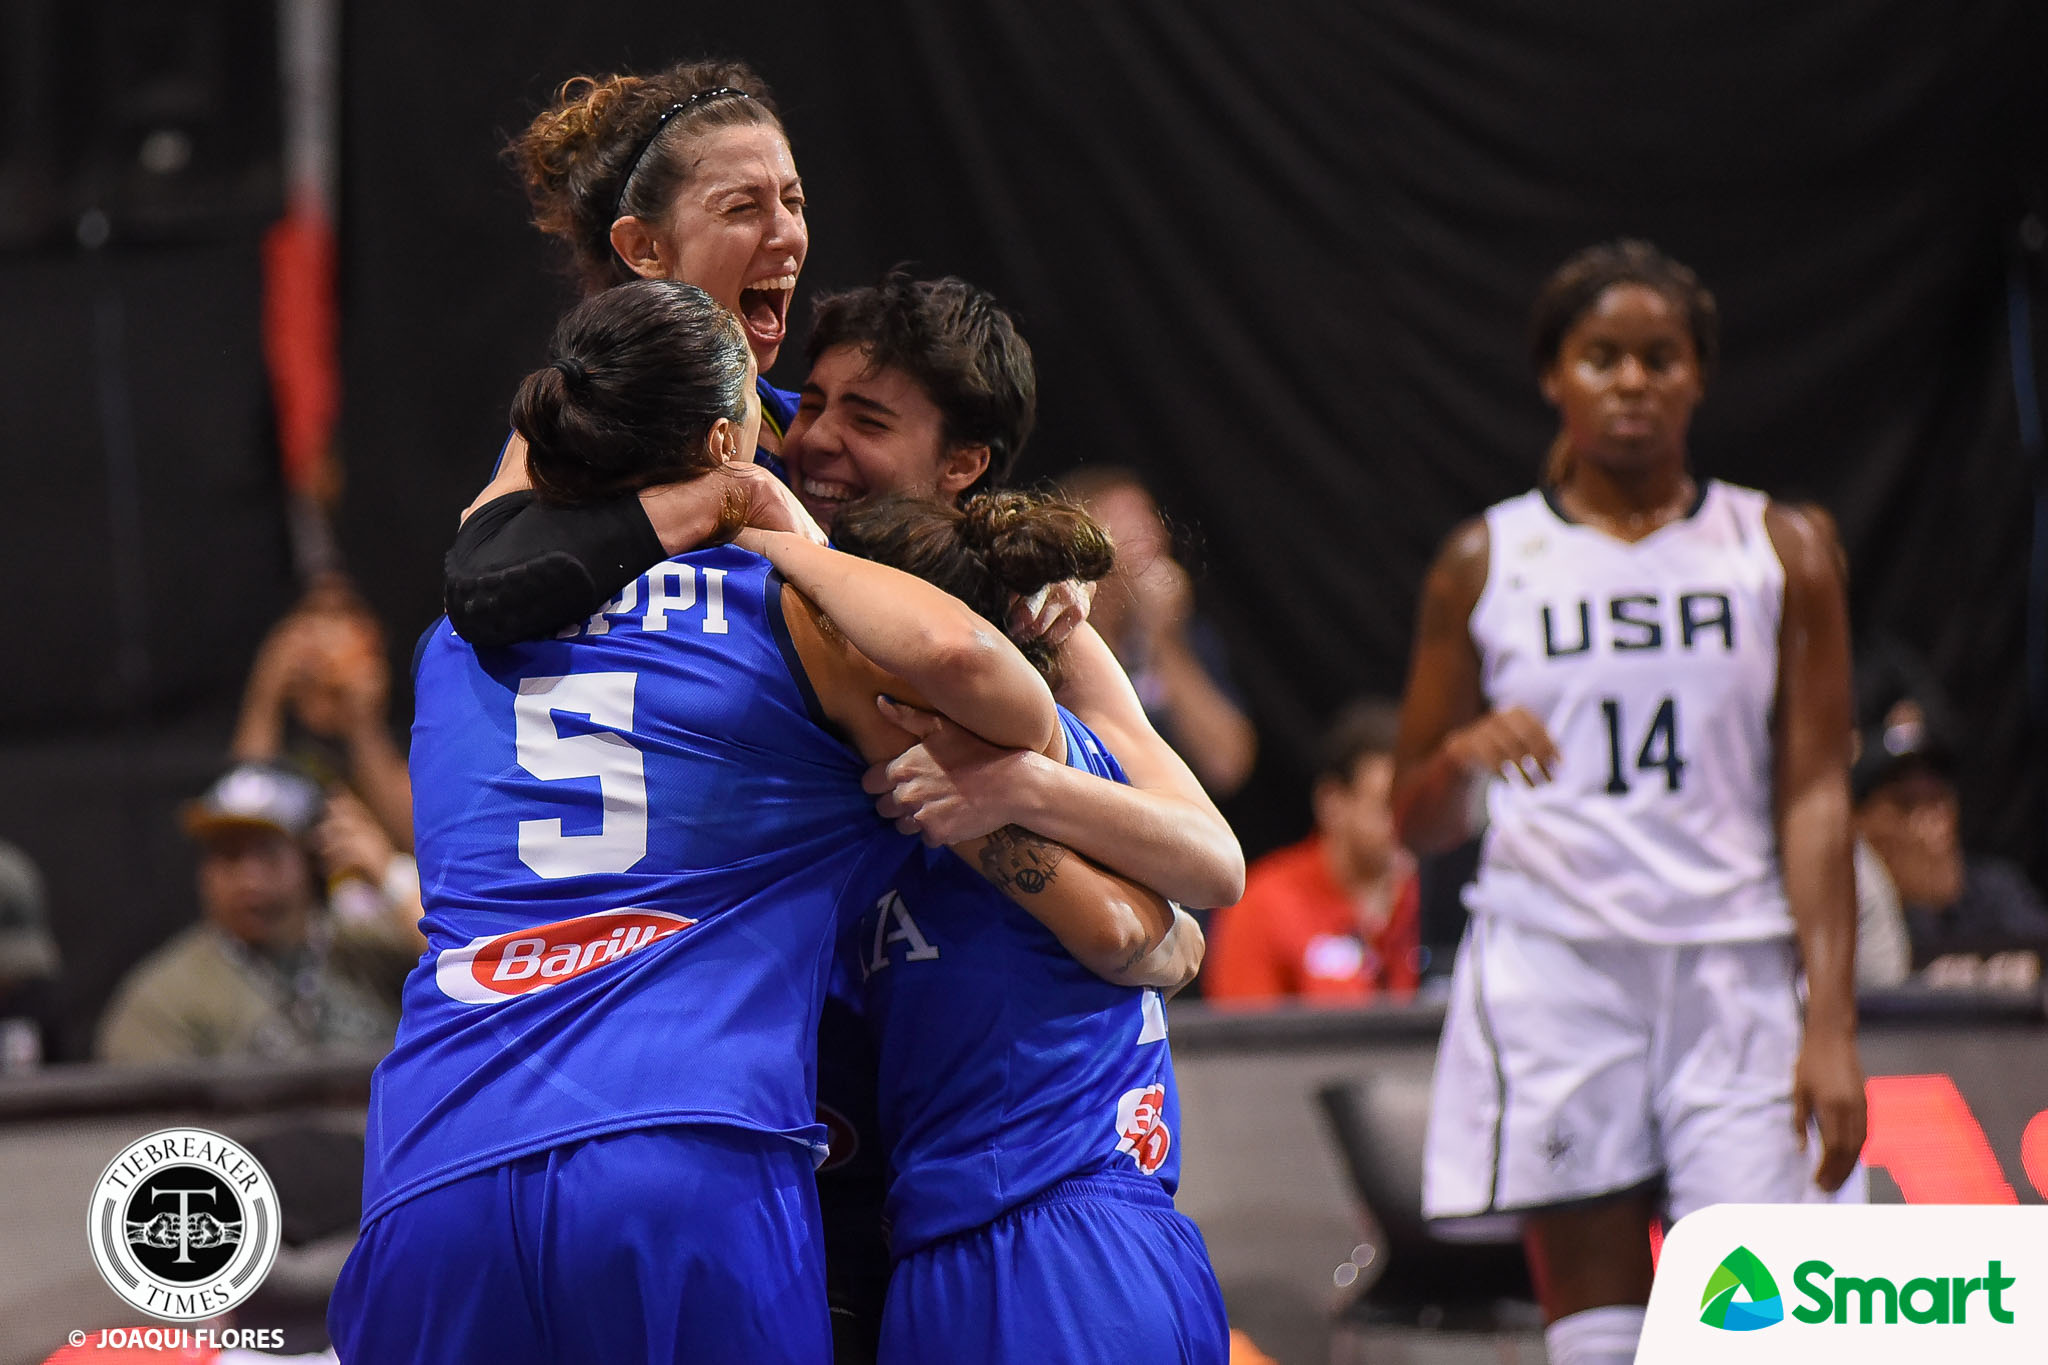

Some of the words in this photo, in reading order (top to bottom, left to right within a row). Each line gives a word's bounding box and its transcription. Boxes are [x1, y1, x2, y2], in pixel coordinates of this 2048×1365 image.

[1542, 592, 1734, 657] USA
[515, 672, 648, 879] 5
[1602, 699, 1686, 794] 14
[492, 925, 658, 982] Barill
